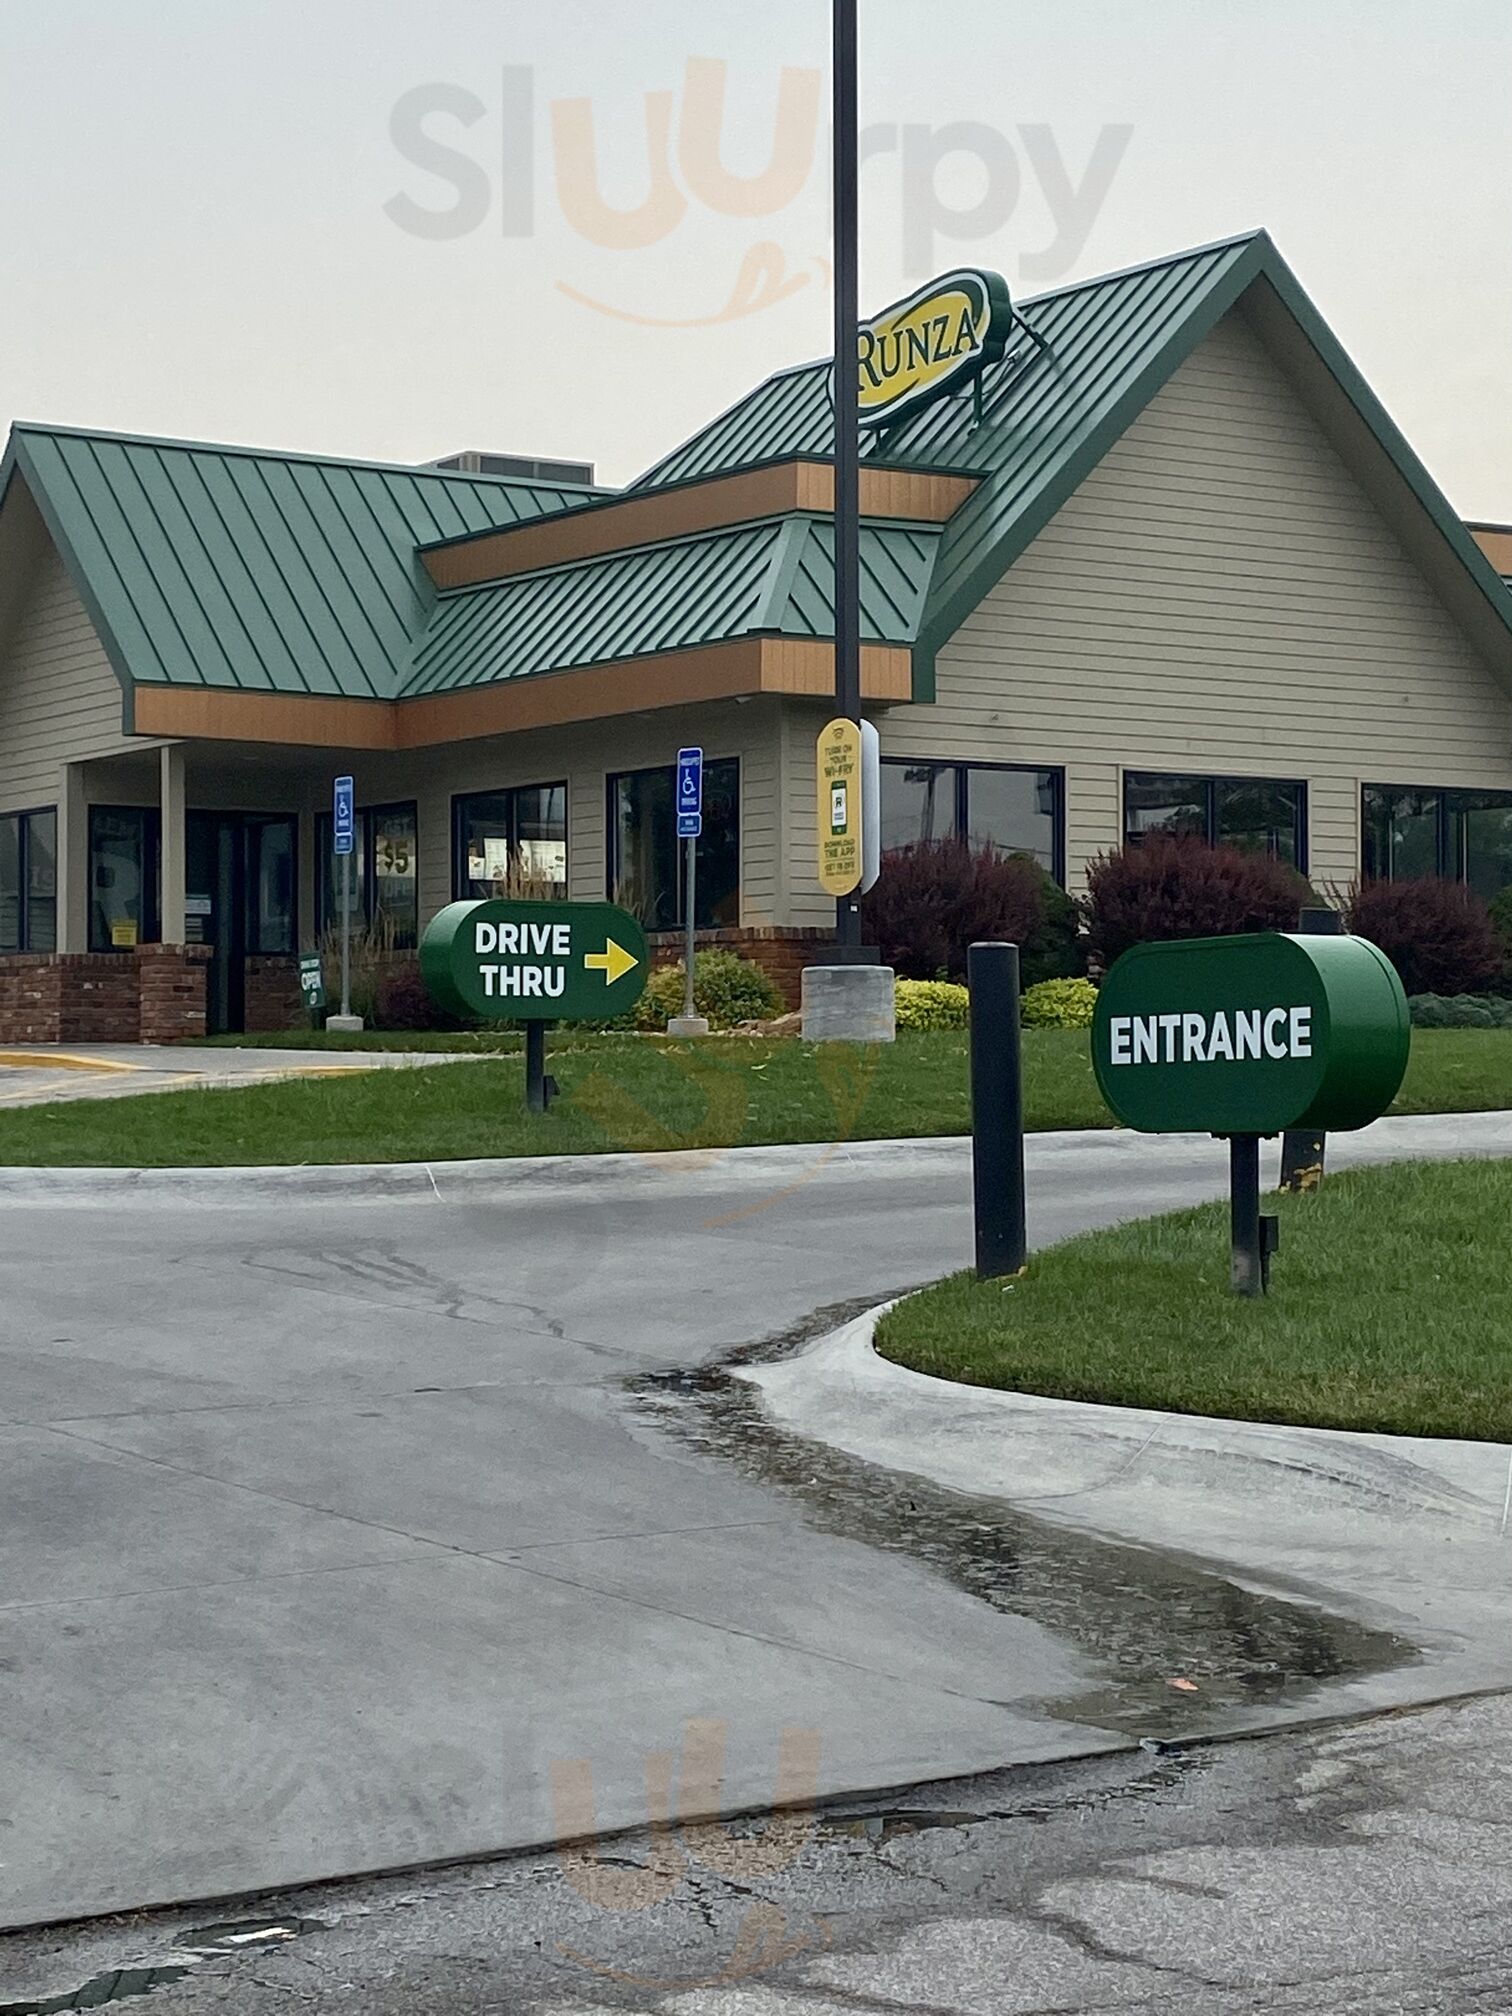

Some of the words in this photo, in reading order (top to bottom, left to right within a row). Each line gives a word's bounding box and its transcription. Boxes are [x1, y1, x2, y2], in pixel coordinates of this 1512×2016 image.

[857, 307, 980, 392] RUNZA
[383, 840, 409, 874] $5
[475, 922, 571, 955] DRIVE
[479, 964, 566, 998] THRU
[1110, 1005, 1313, 1066] ENTRANCE
